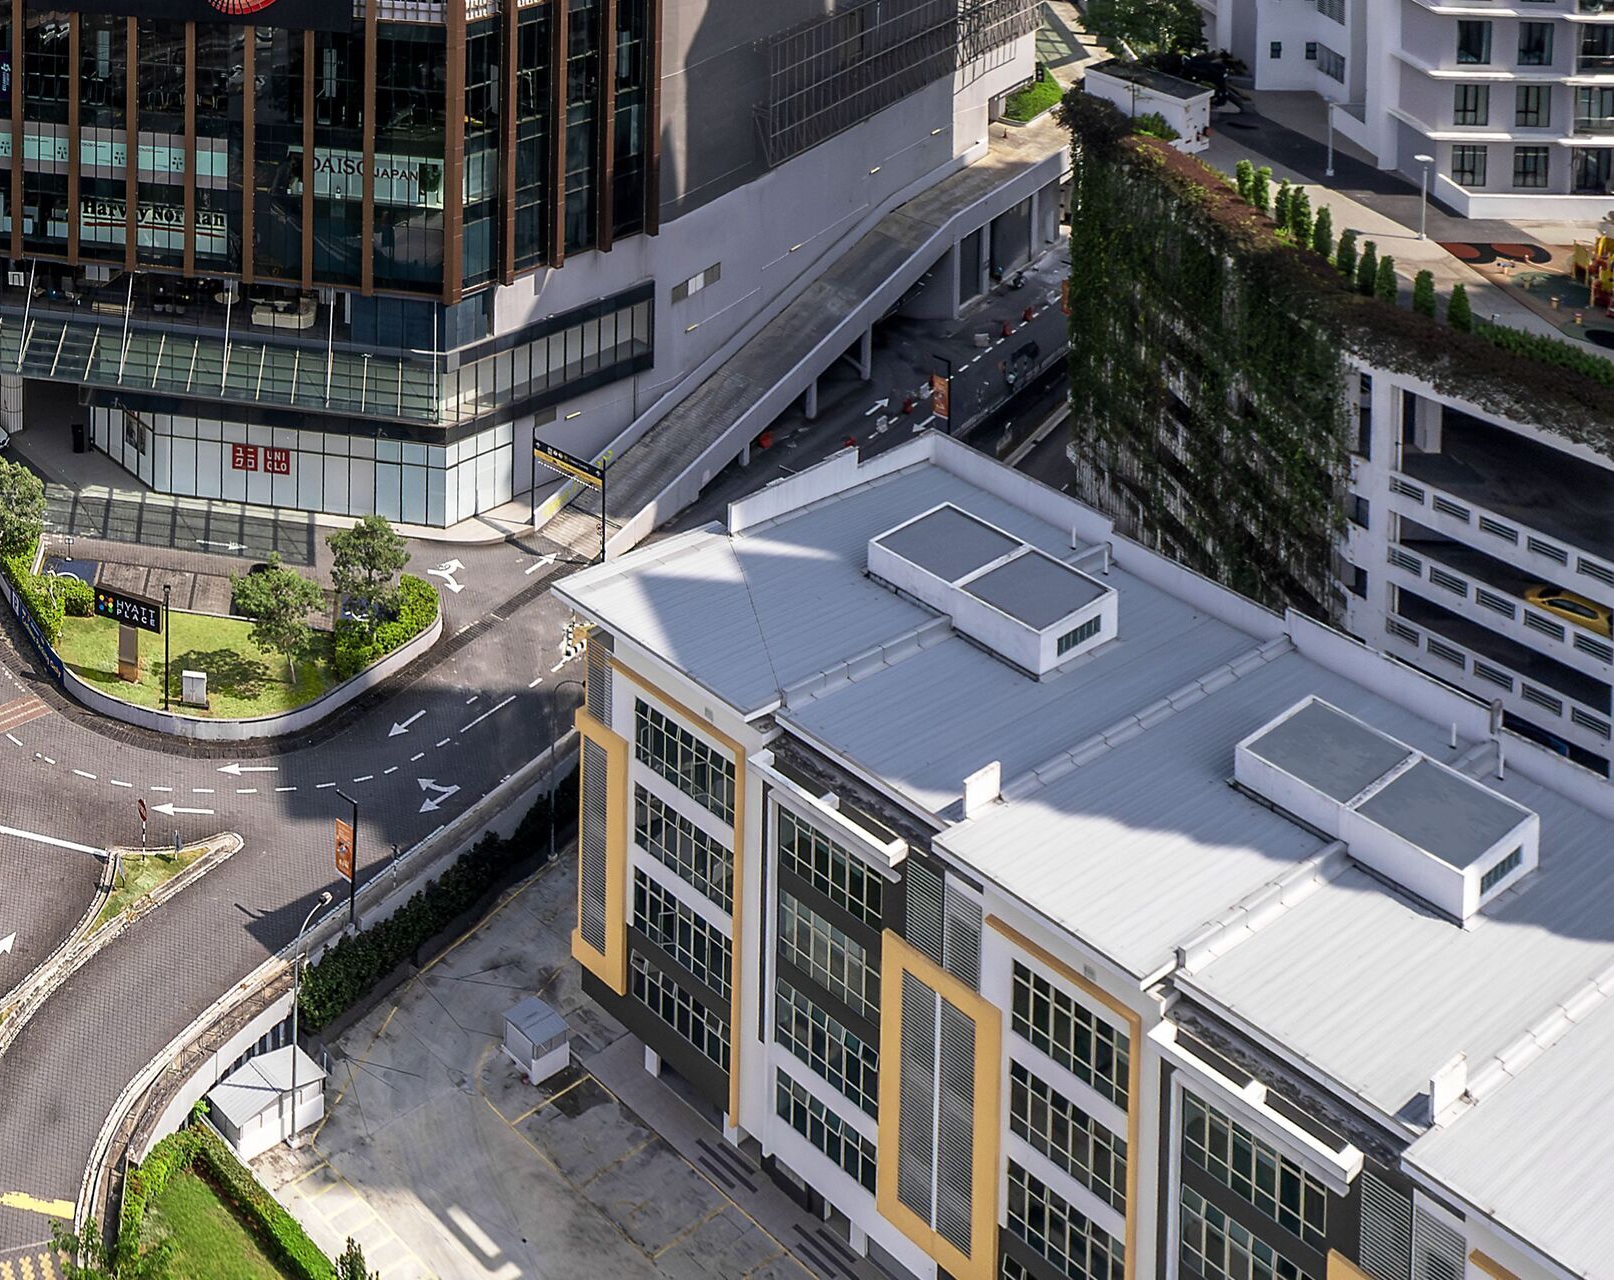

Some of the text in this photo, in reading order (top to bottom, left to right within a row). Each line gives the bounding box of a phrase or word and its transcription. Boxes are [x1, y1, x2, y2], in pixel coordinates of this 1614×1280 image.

[374, 167, 418, 181] JAPAN
[83, 198, 151, 222] Harvy
[267, 450, 286, 461] UNI
[116, 599, 156, 619] HYATT
[116, 609, 156, 627] PLACE
